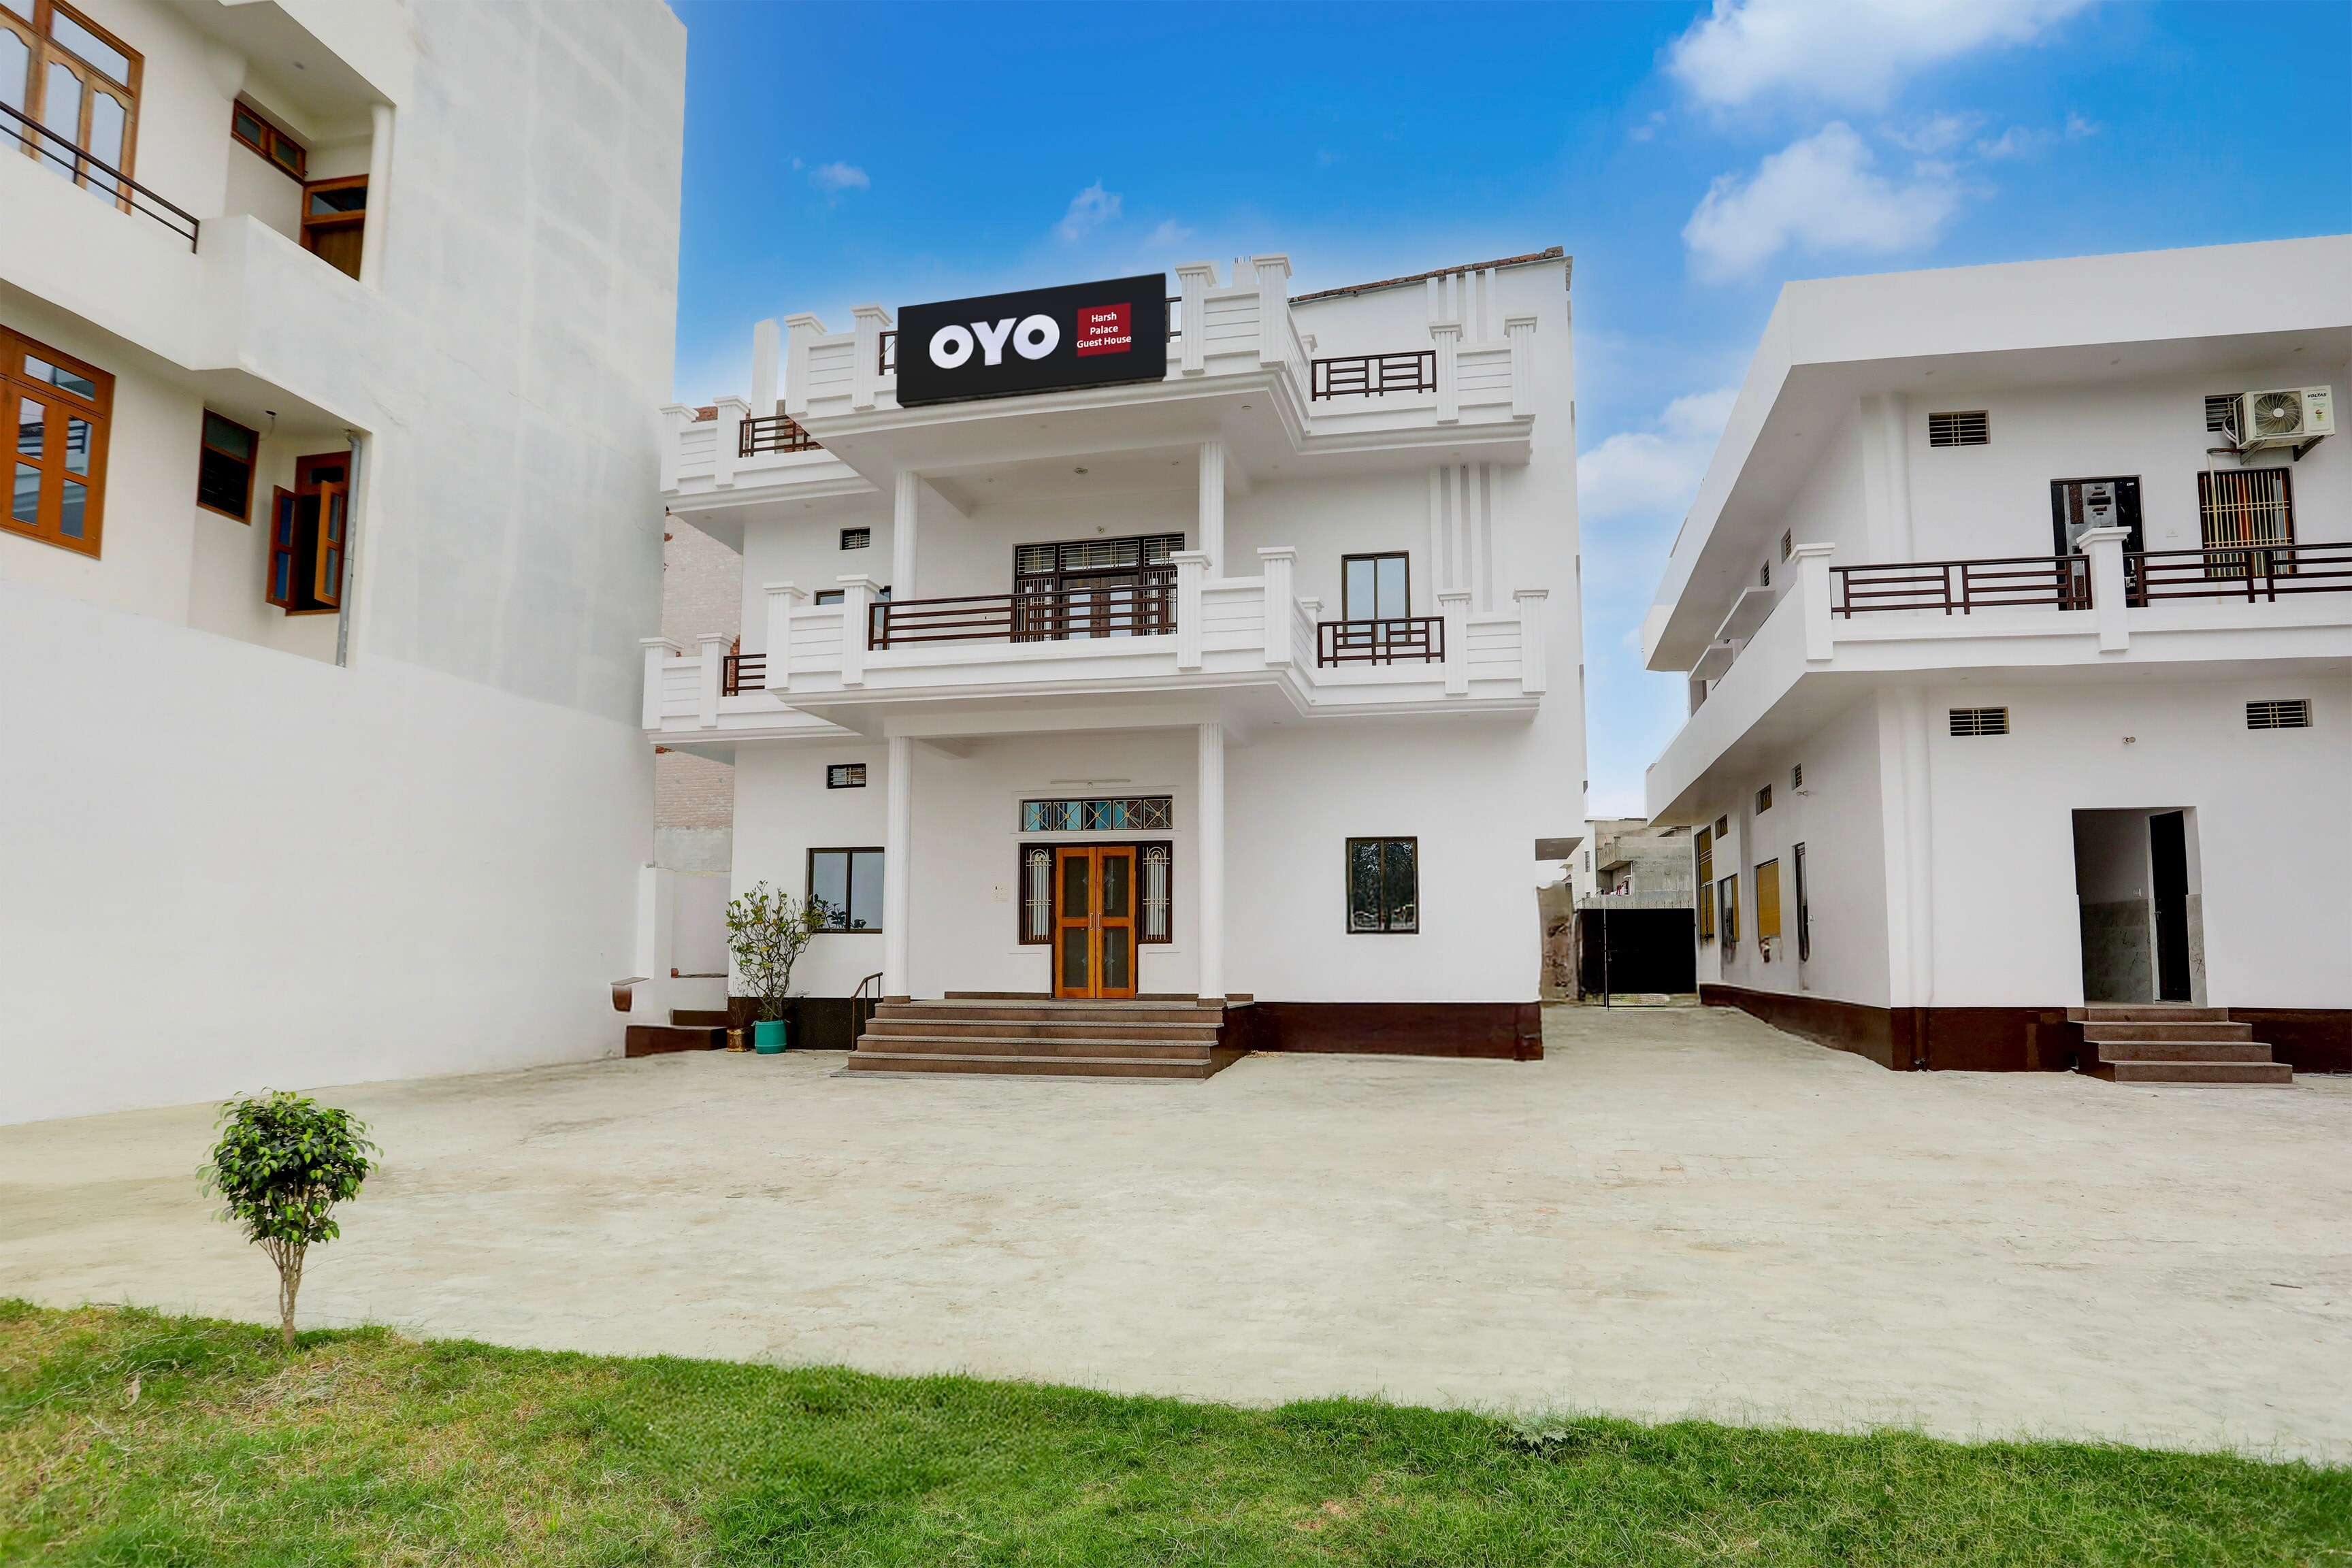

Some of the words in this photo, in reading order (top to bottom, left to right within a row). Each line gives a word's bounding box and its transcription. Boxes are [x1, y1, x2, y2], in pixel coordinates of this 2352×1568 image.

[1091, 312, 1117, 323] Harsh
[1090, 325, 1118, 335] Palace
[929, 314, 1060, 370] OYO
[1077, 338, 1102, 348] Guest
[1104, 336, 1132, 345] House
